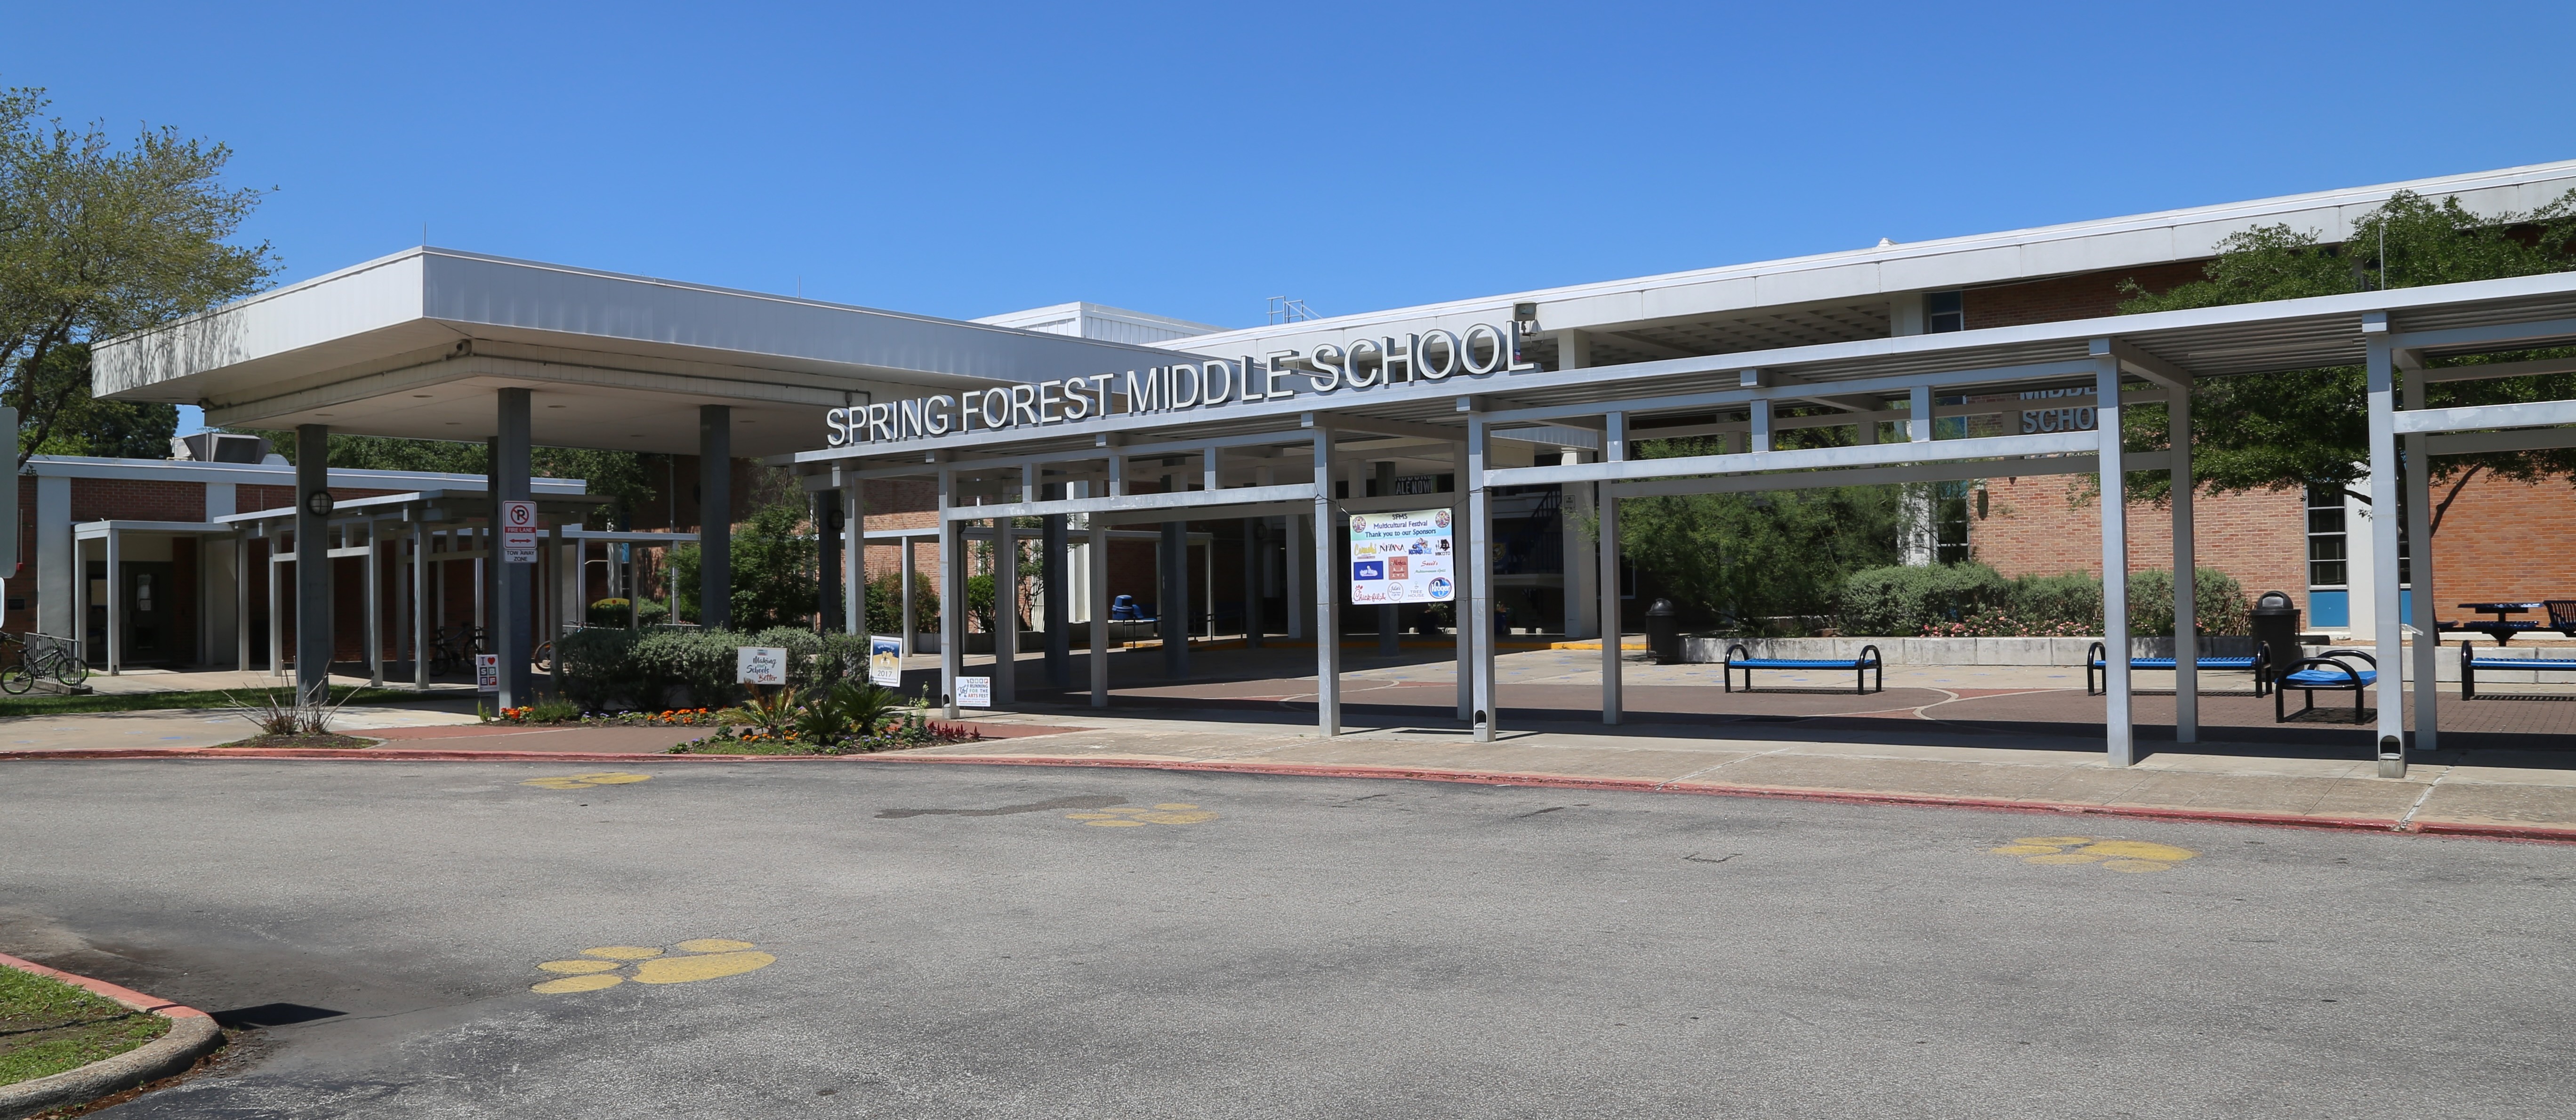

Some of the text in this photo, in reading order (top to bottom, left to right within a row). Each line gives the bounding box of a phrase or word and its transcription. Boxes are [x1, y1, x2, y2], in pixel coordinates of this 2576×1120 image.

[826, 320, 1536, 446] SPRING FOREST MIDDLE SCHOOL
[2023, 407, 2098, 433] SCHO
[1412, 480, 1433, 494] NOW!
[1373, 521, 1407, 529] Multicultural
[481, 657, 485, 666] I
[753, 655, 776, 669] Making
[746, 664, 770, 675] Schools
[758, 673, 777, 683] Better
